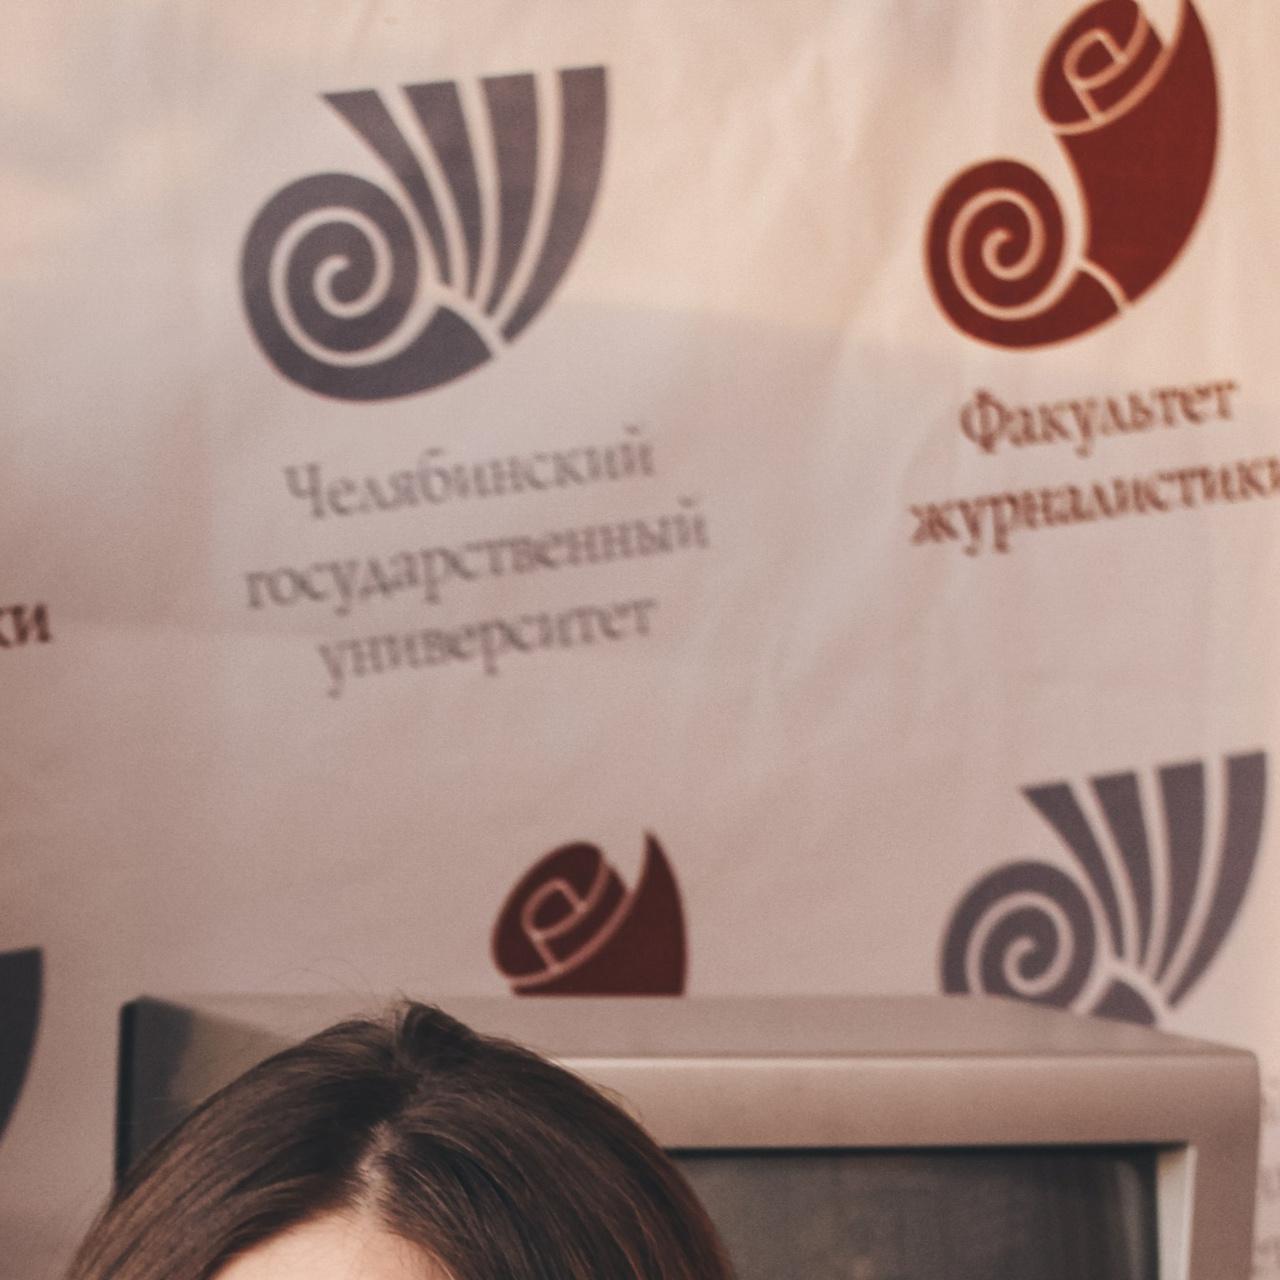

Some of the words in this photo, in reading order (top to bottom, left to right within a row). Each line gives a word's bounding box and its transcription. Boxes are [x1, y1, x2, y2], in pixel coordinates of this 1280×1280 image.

[959, 379, 1238, 459] Факультет
[283, 424, 656, 519] Челябинский
[244, 495, 710, 617] государственный
[319, 598, 658, 699] университет
